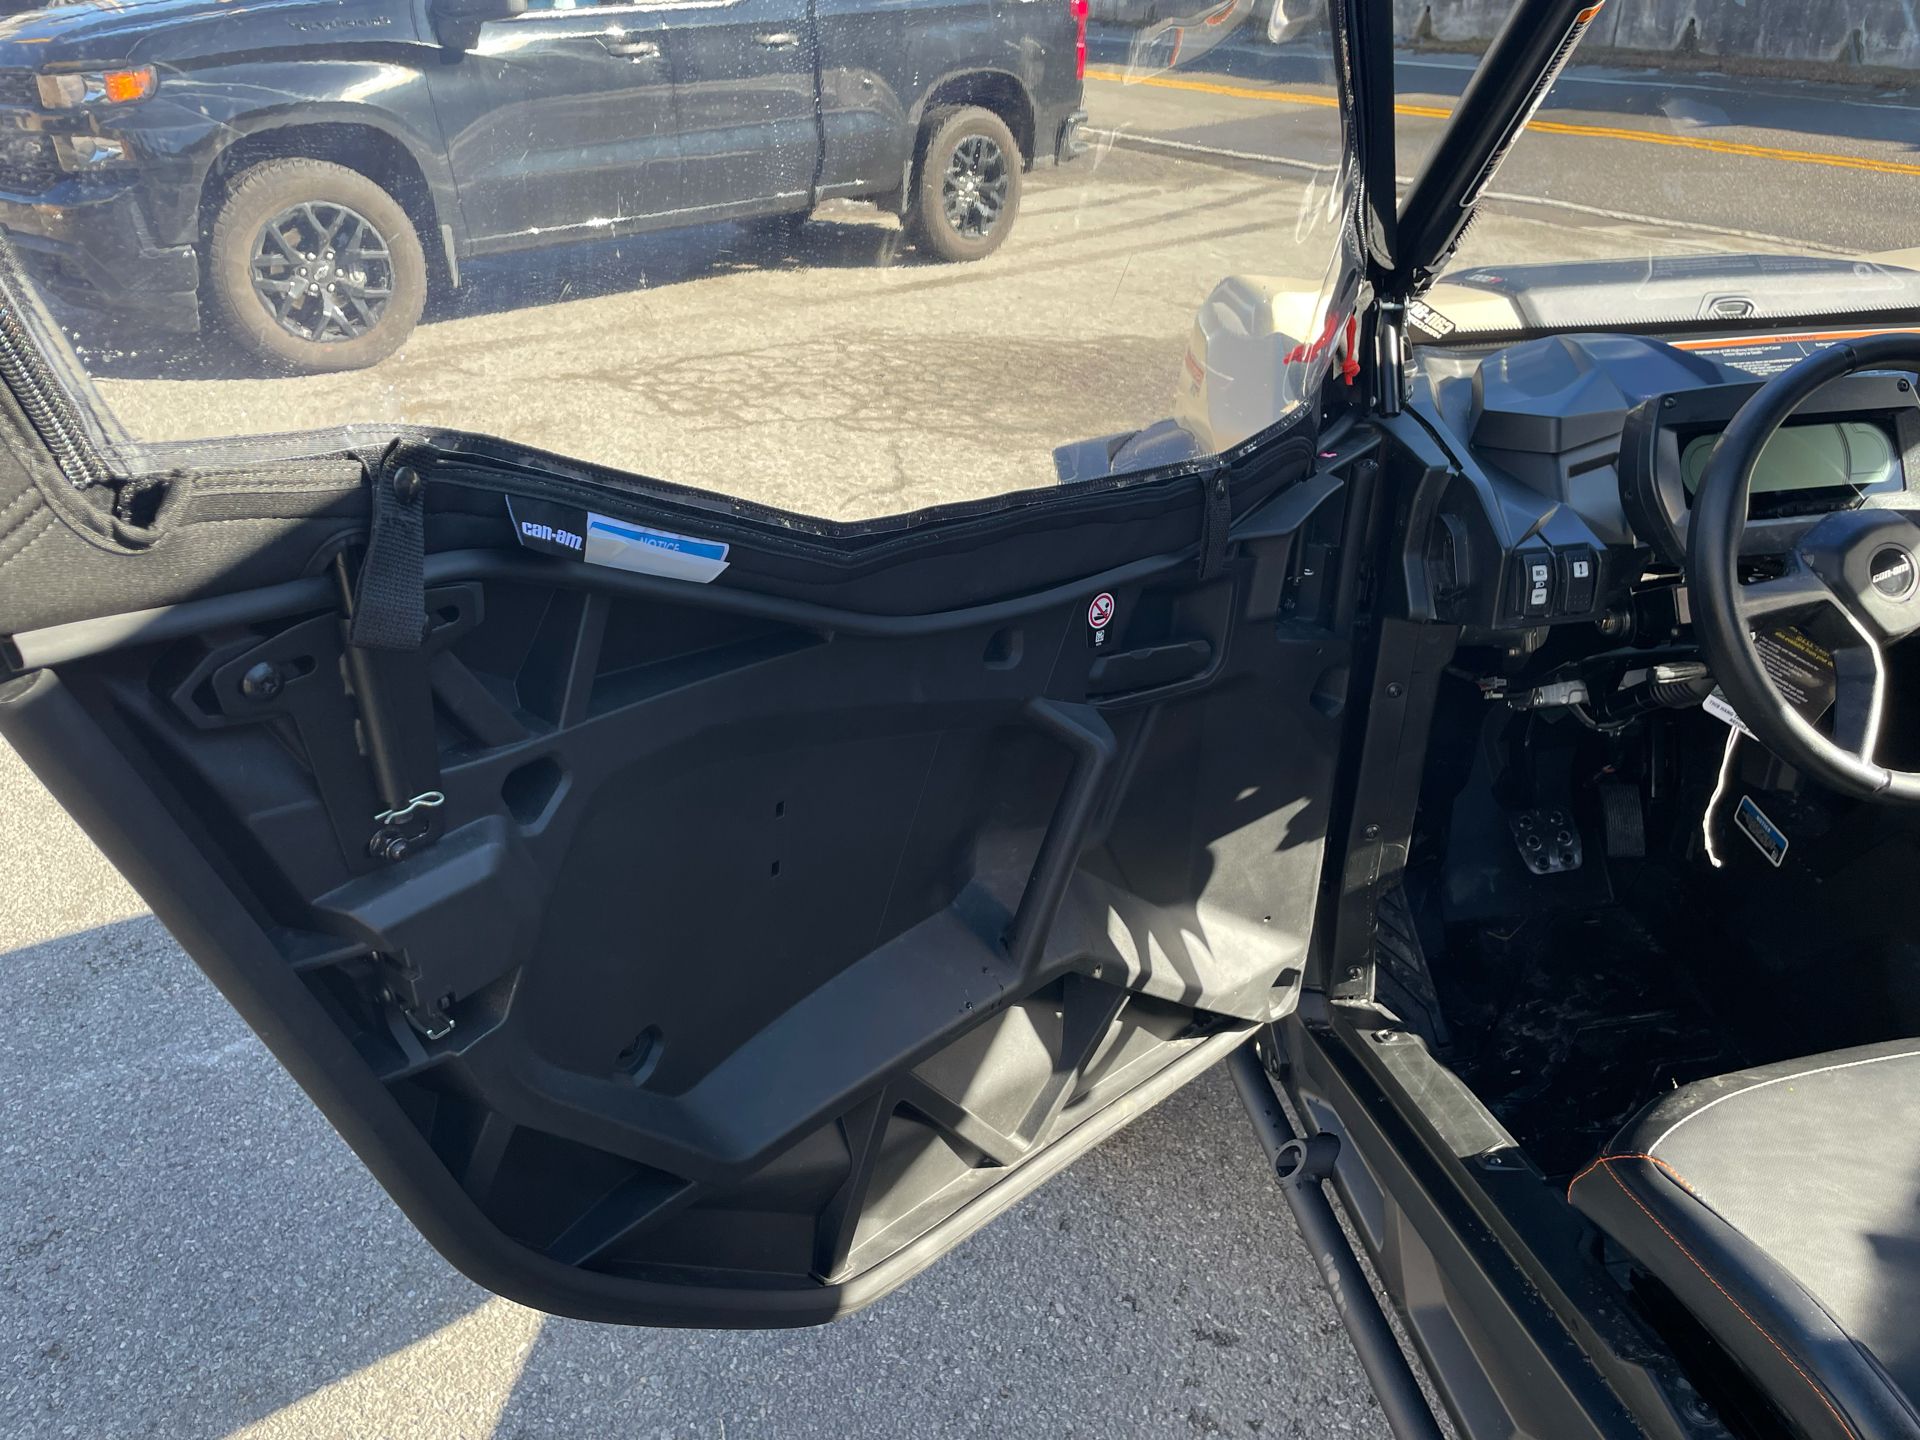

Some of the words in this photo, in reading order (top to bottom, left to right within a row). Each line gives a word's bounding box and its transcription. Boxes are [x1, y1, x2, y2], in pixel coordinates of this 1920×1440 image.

[521, 522, 583, 550] can-am
[640, 536, 680, 552] NOTICE
[1872, 562, 1910, 583] can-am
